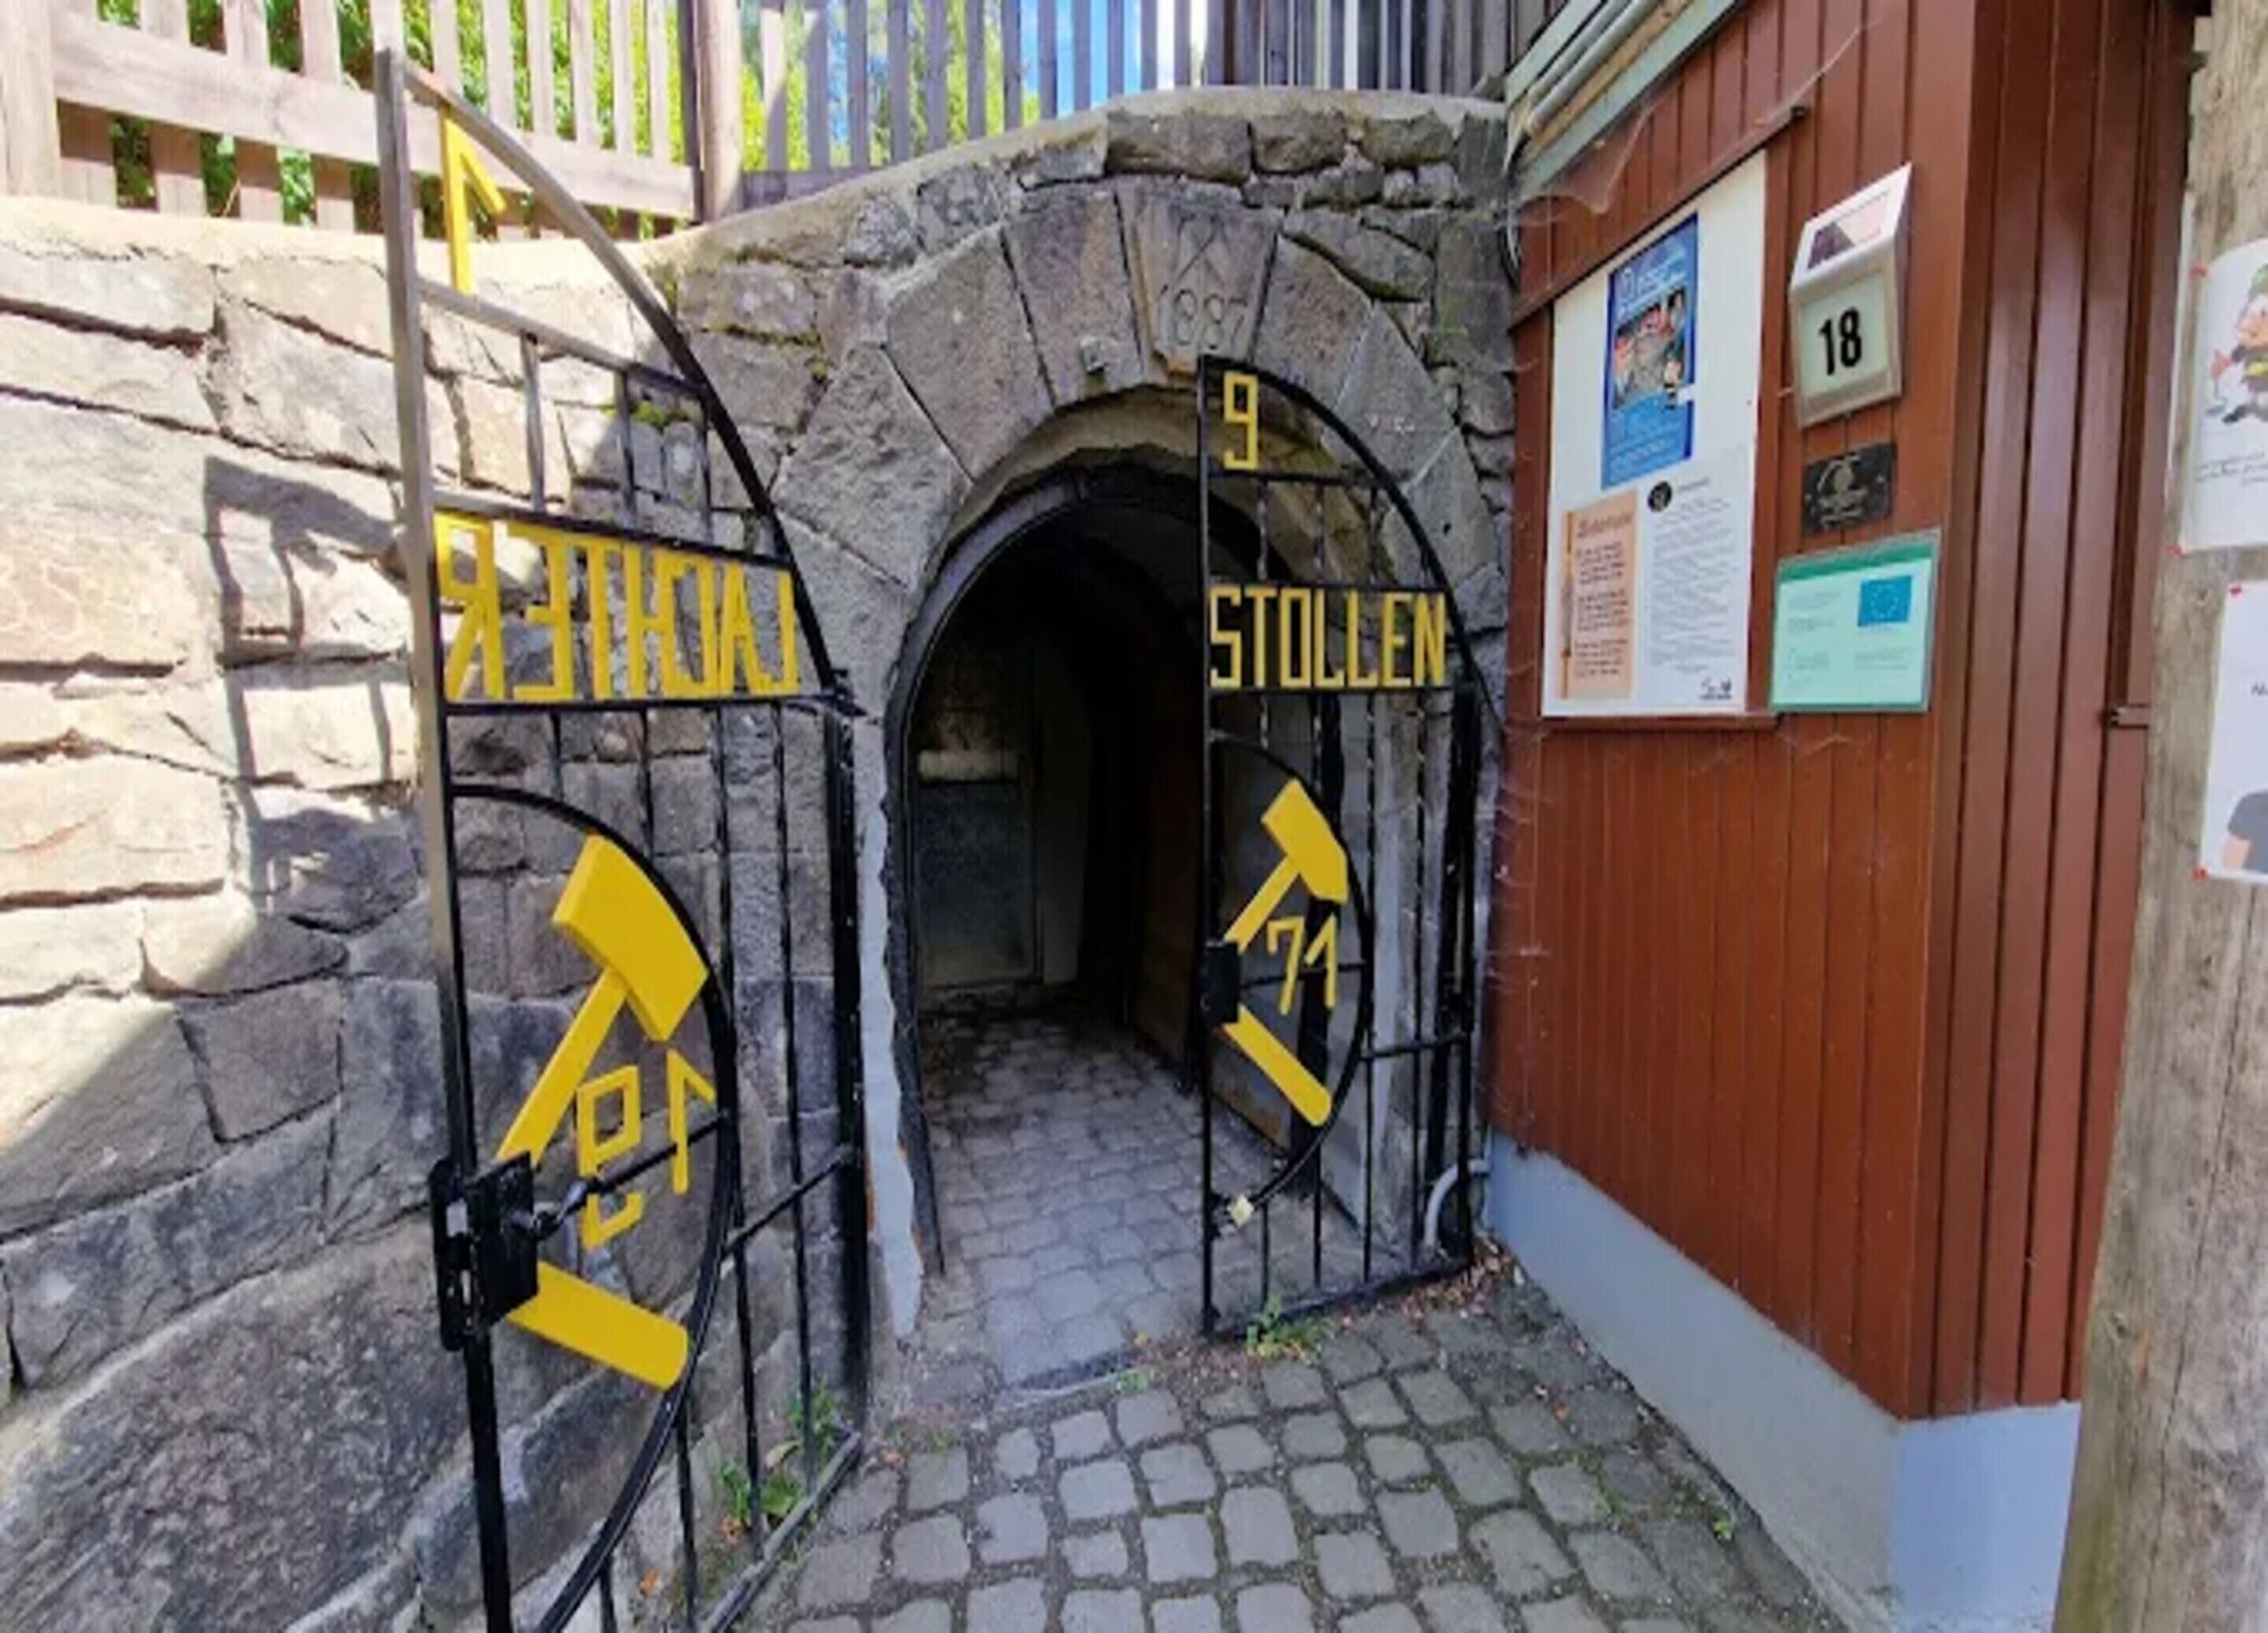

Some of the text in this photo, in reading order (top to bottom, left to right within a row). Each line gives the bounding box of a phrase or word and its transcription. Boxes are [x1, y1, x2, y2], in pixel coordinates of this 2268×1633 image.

[1818, 307, 1863, 376] 18
[1224, 370, 1258, 470] 9
[1210, 585, 1446, 687] STOLLEN
[1267, 914, 1337, 1016] 71
